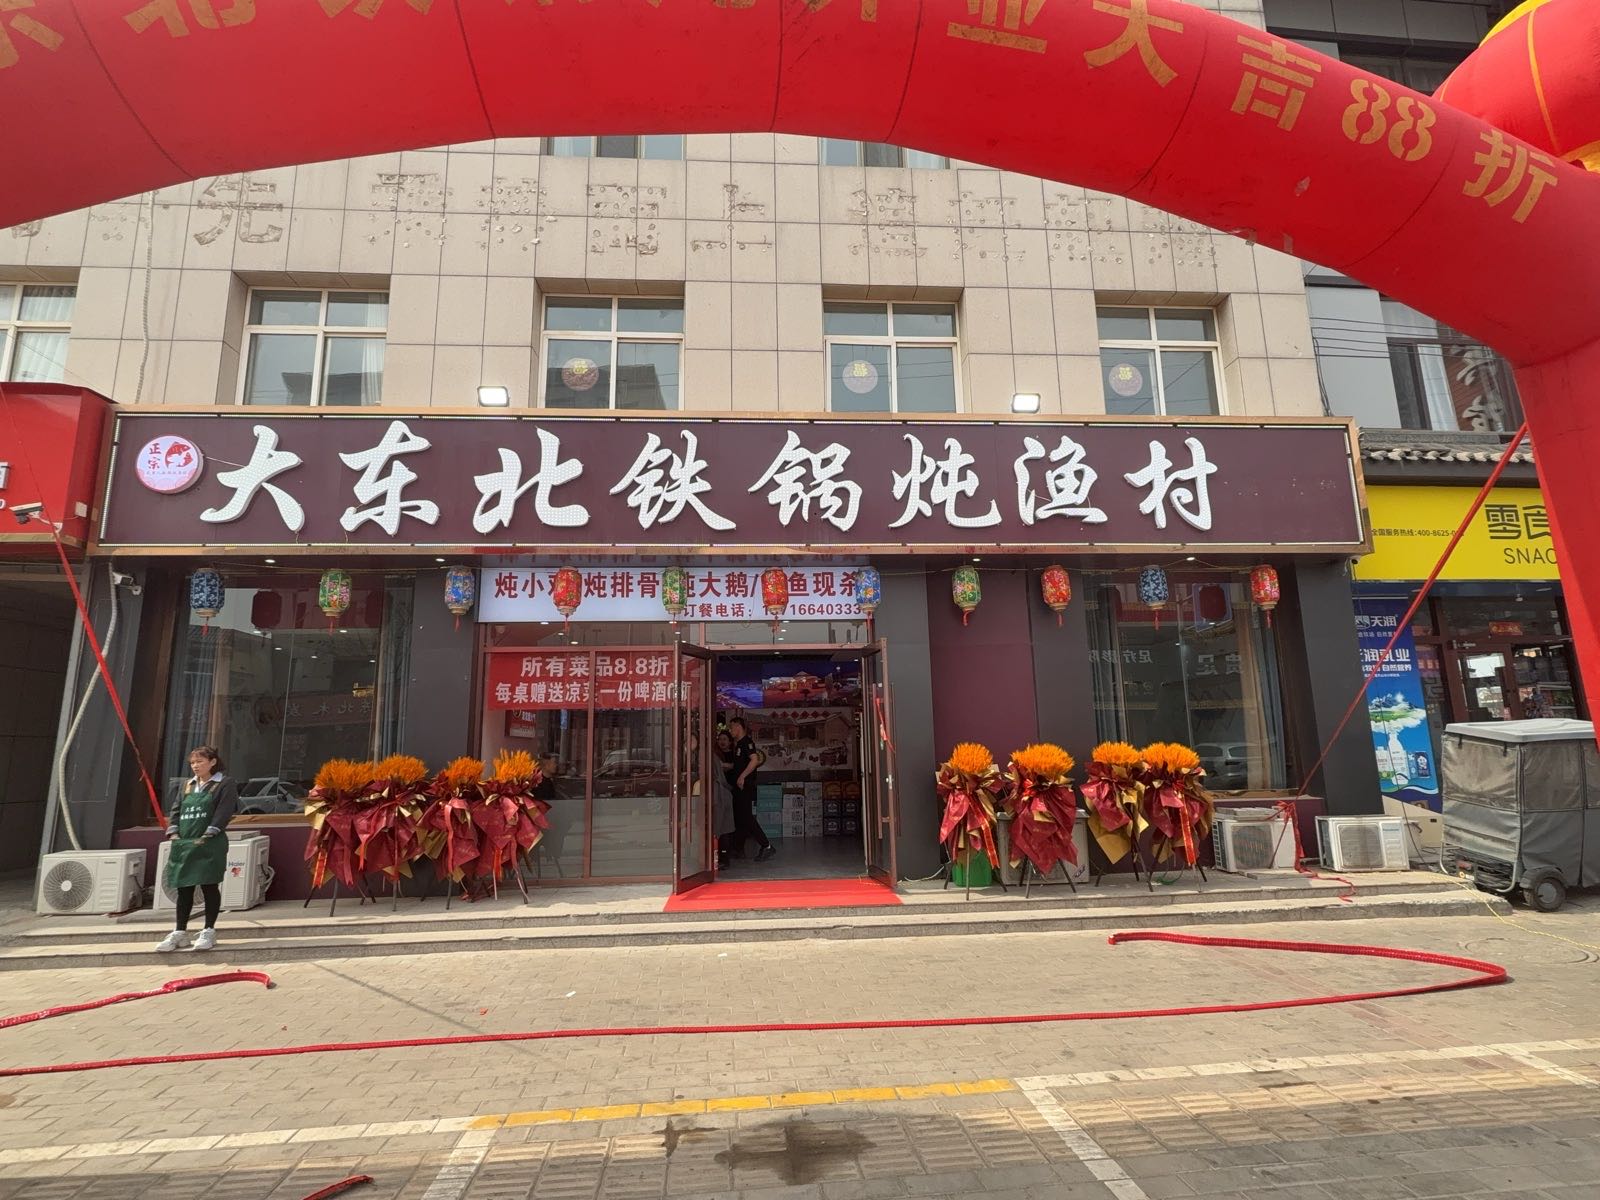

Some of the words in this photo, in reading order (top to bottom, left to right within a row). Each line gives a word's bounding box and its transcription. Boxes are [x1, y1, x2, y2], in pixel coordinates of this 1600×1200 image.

[148, 443, 161, 470] 正宗
[200, 420, 1218, 535] 大东北铁锅炖渔村
[1370, 615, 1397, 627] 天润
[521, 655, 670, 677] 所有菜品8.8折
